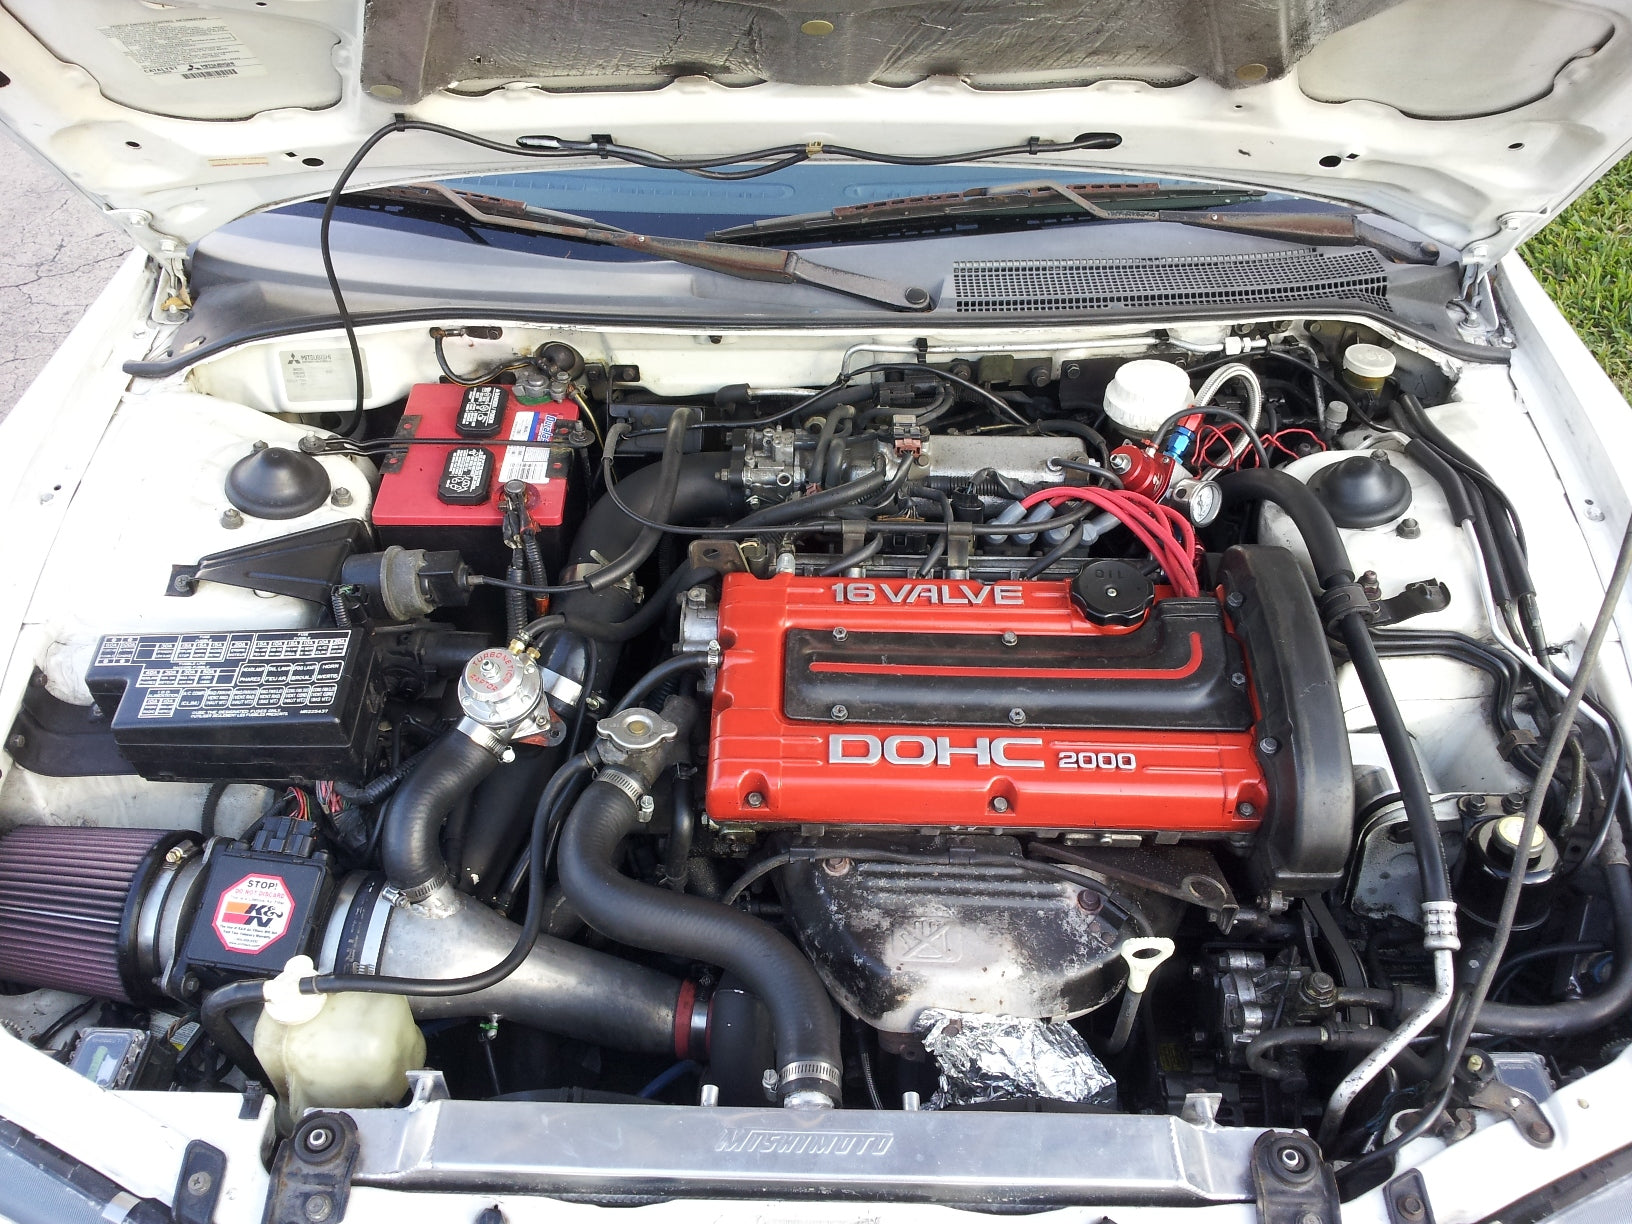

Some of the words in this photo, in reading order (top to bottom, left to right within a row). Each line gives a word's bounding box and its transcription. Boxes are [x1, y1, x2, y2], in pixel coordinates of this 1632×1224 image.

[1095, 569, 1128, 579] OIL
[879, 583, 1025, 606] VALVE
[472, 651, 514, 684] TURBONETICS
[470, 673, 498, 692] RAPTOR
[828, 733, 1046, 768] DOHC
[1058, 751, 1137, 772] 2000
[247, 880, 278, 890] STOP!
[258, 890, 285, 899] DISCARD
[715, 1128, 895, 1156] MISHIMOTO
